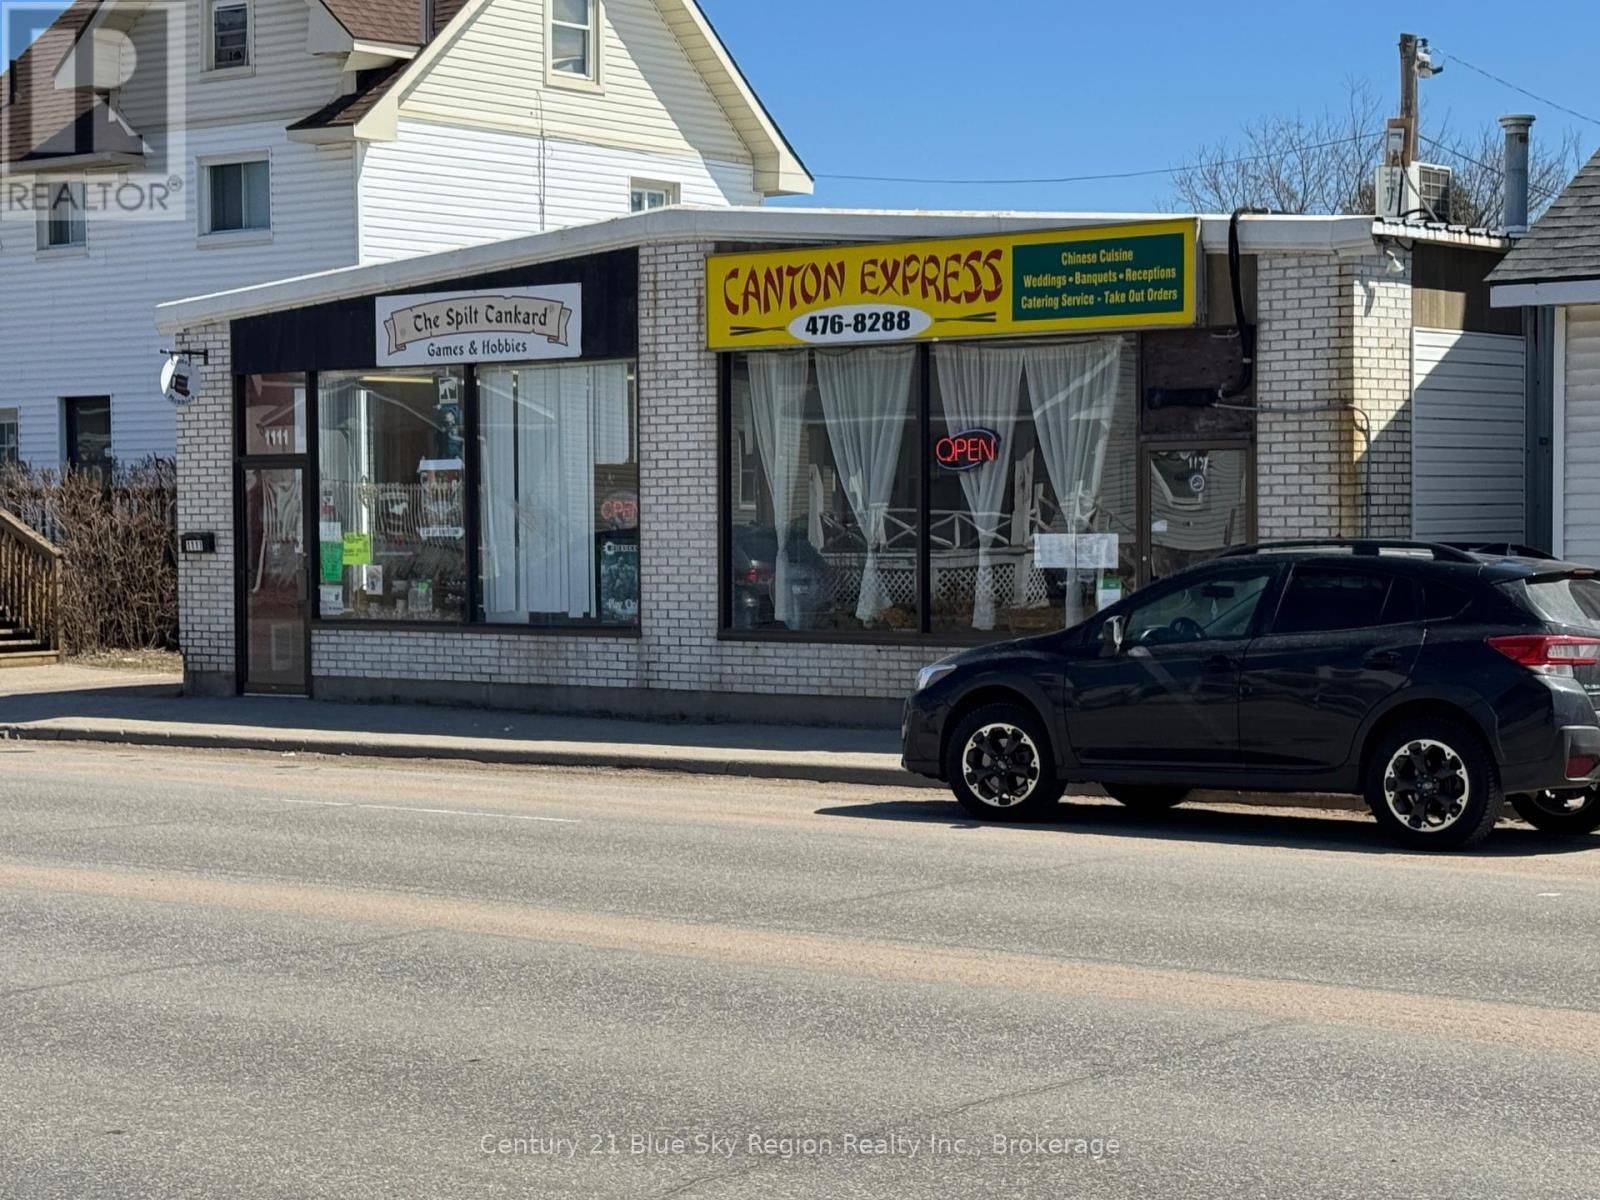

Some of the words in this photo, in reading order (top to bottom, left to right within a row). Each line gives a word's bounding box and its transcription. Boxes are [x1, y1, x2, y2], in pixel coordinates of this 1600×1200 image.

[1061, 251, 1097, 266] Chinese
[1099, 248, 1134, 263] Cuisine
[723, 260, 846, 316] CANTON
[859, 248, 1004, 305] EXPRESS
[1023, 273, 1067, 288] Weddings
[1074, 270, 1117, 287] Banquets
[1125, 266, 1177, 282] Receptions
[1021, 294, 1059, 310] Catering
[1061, 292, 1095, 307] Service
[1104, 290, 1126, 305] Take
[1128, 289, 1145, 303] Out
[1147, 287, 1178, 301] Orders
[413, 312, 440, 332] The
[446, 307, 479, 330] Spilt
[484, 304, 548, 326] Tankard
[804, 310, 911, 336] 476-8288
[427, 342, 464, 357] Games
[468, 341, 478, 355] &
[482, 339, 528, 354] Hobbies
[264, 429, 289, 446] 1111
[935, 438, 996, 462] OPEN
